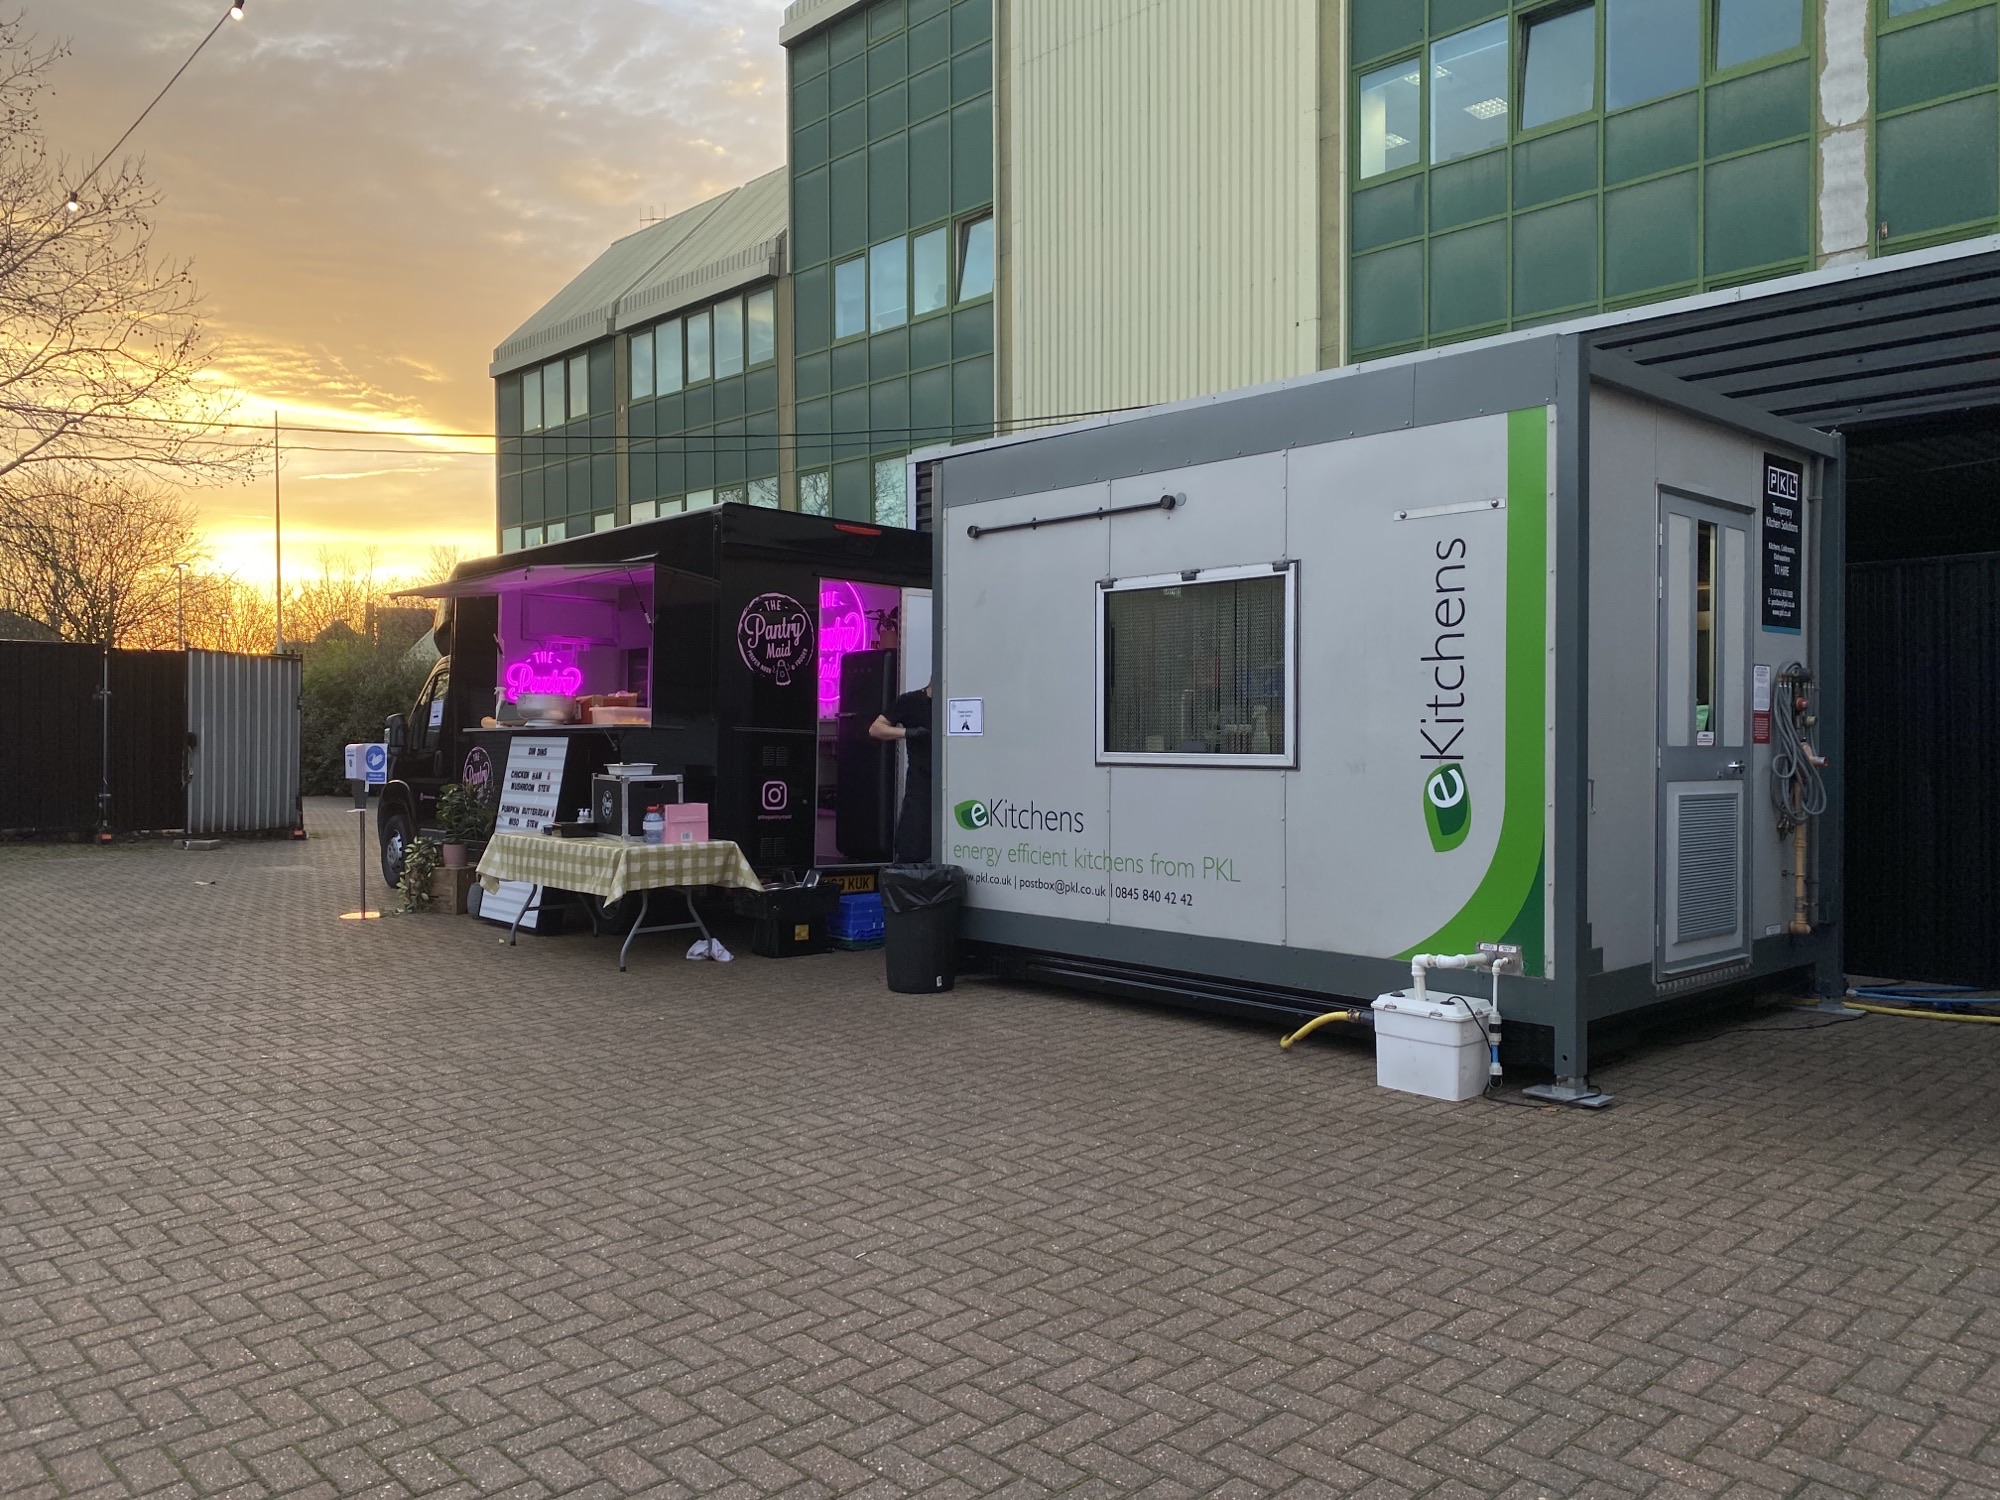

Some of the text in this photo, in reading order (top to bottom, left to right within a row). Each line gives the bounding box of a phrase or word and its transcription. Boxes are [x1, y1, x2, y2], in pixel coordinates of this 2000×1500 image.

[764, 600, 782, 612] THE
[744, 613, 806, 648] Pantry
[532, 651, 554, 664] THE
[766, 640, 792, 659] Maid
[1420, 537, 1466, 809] eKitchens
[510, 770, 530, 781] CHICKEN
[511, 782, 551, 793] MUSHROOM STEW
[501, 804, 520, 815] PUMPKIN
[521, 806, 549, 818] BUTTERBEAN
[971, 798, 1084, 833] eKitchens
[508, 818, 539, 829] MISO STEW
[953, 842, 1242, 883] energy efficient kitchens from PKL
[847, 875, 870, 891] KUK
[1019, 878, 1106, 897] postbox@pkl.co.uk
[1115, 886, 1139, 900] 0845
[1142, 889, 1161, 903] 840
[1164, 892, 1177, 905] 42
[1180, 893, 1193, 907] 42
